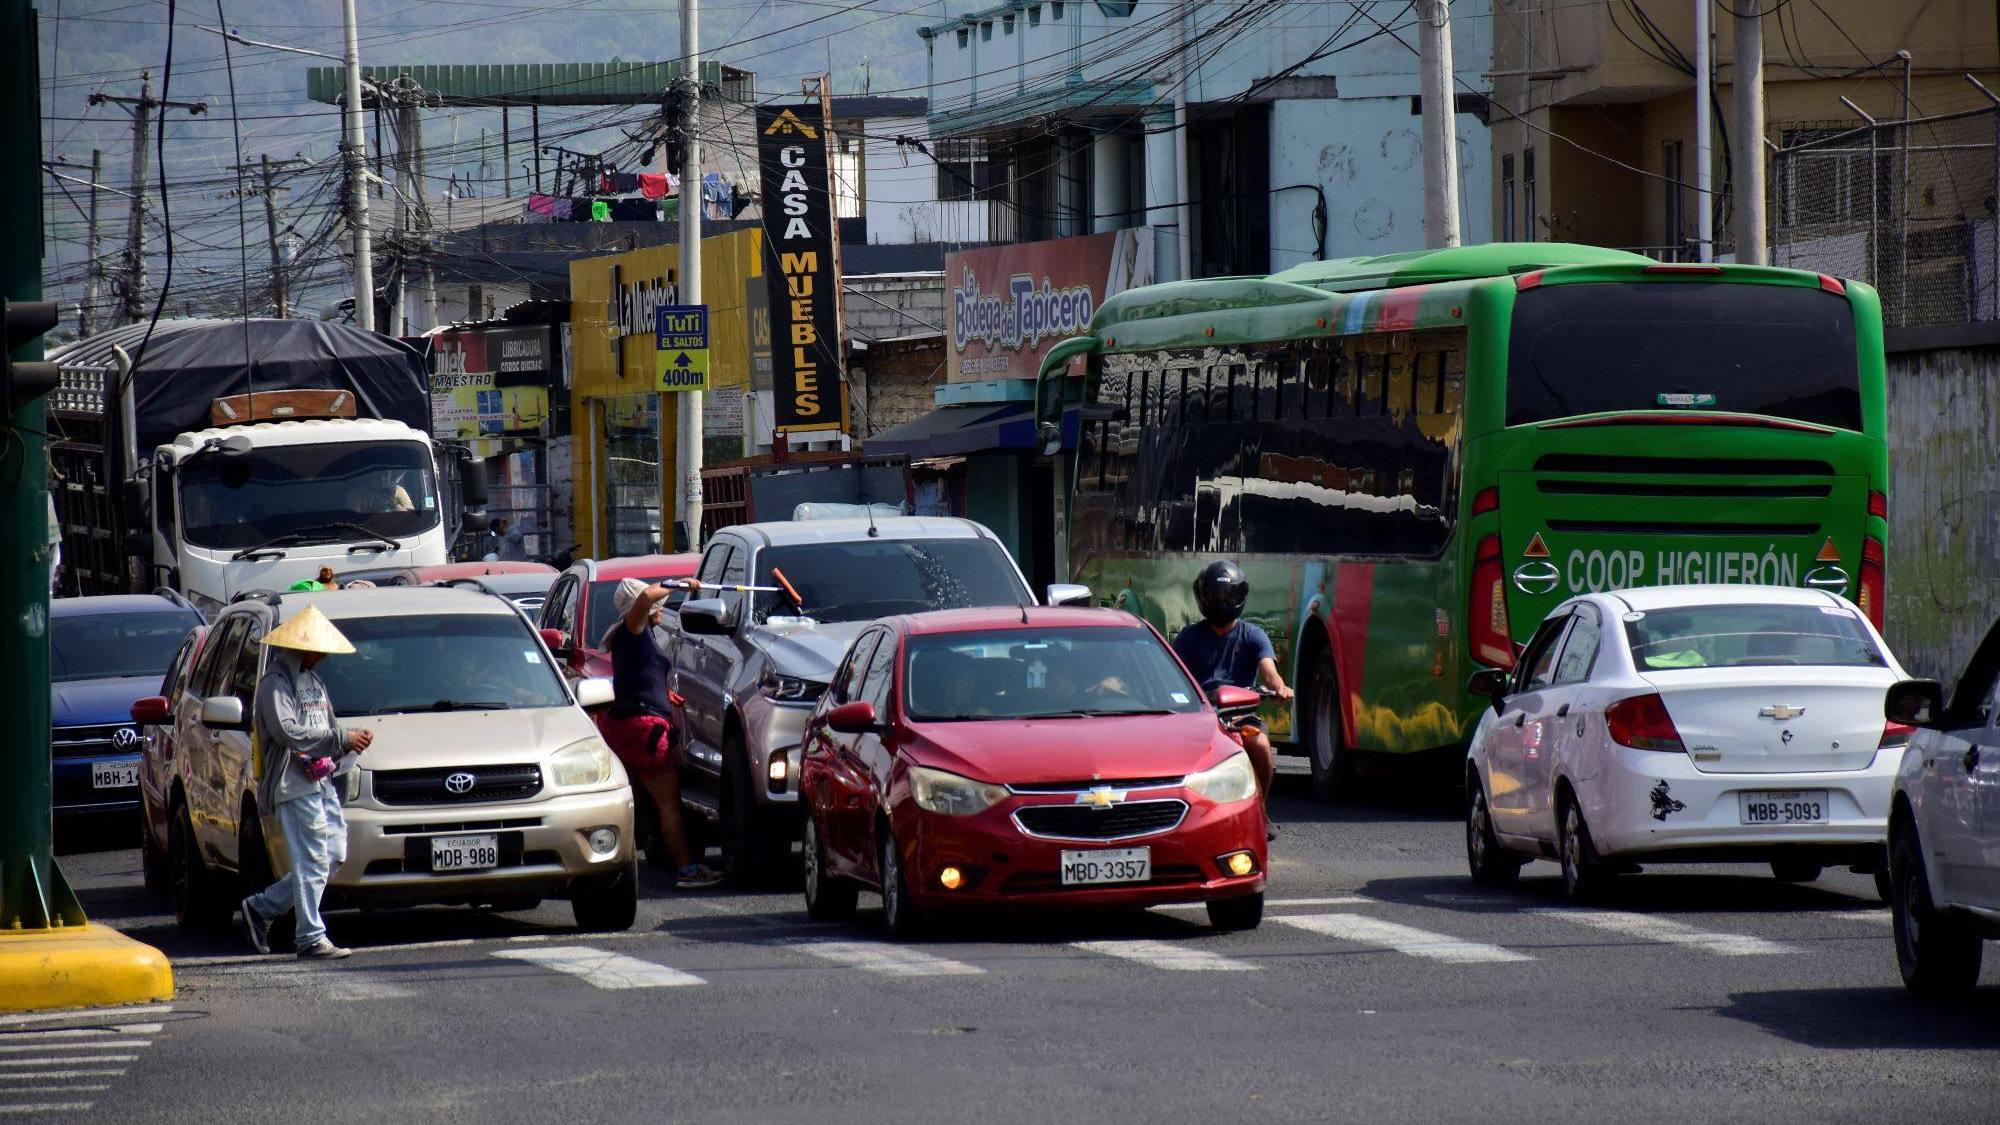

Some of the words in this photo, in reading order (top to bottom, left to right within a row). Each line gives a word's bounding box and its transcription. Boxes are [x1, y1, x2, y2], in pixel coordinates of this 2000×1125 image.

[780, 145, 812, 239] CASA
[964, 265, 975, 298] La
[620, 283, 631, 337] La
[955, 290, 1000, 345] Bodega
[1001, 303, 1016, 340] del
[1011, 280, 1091, 344] Tapicero
[753, 306, 770, 346] CAS
[781, 251, 821, 416] MUEBLES
[502, 339, 541, 358] LUBRICADORA
[662, 337, 672, 348] EL
[674, 336, 704, 347] SALTOS
[435, 374, 491, 387] MAESTRO
[663, 368, 704, 386] 400m
[1657, 543, 1798, 587] HIGUERÓN
[95, 770, 138, 786] MBH-1
[1747, 803, 1821, 821] MBB-5093
[447, 839, 481, 847] ECUADOR
[434, 847, 495, 866] MDB-988
[1065, 860, 1146, 881] MBD-3357
